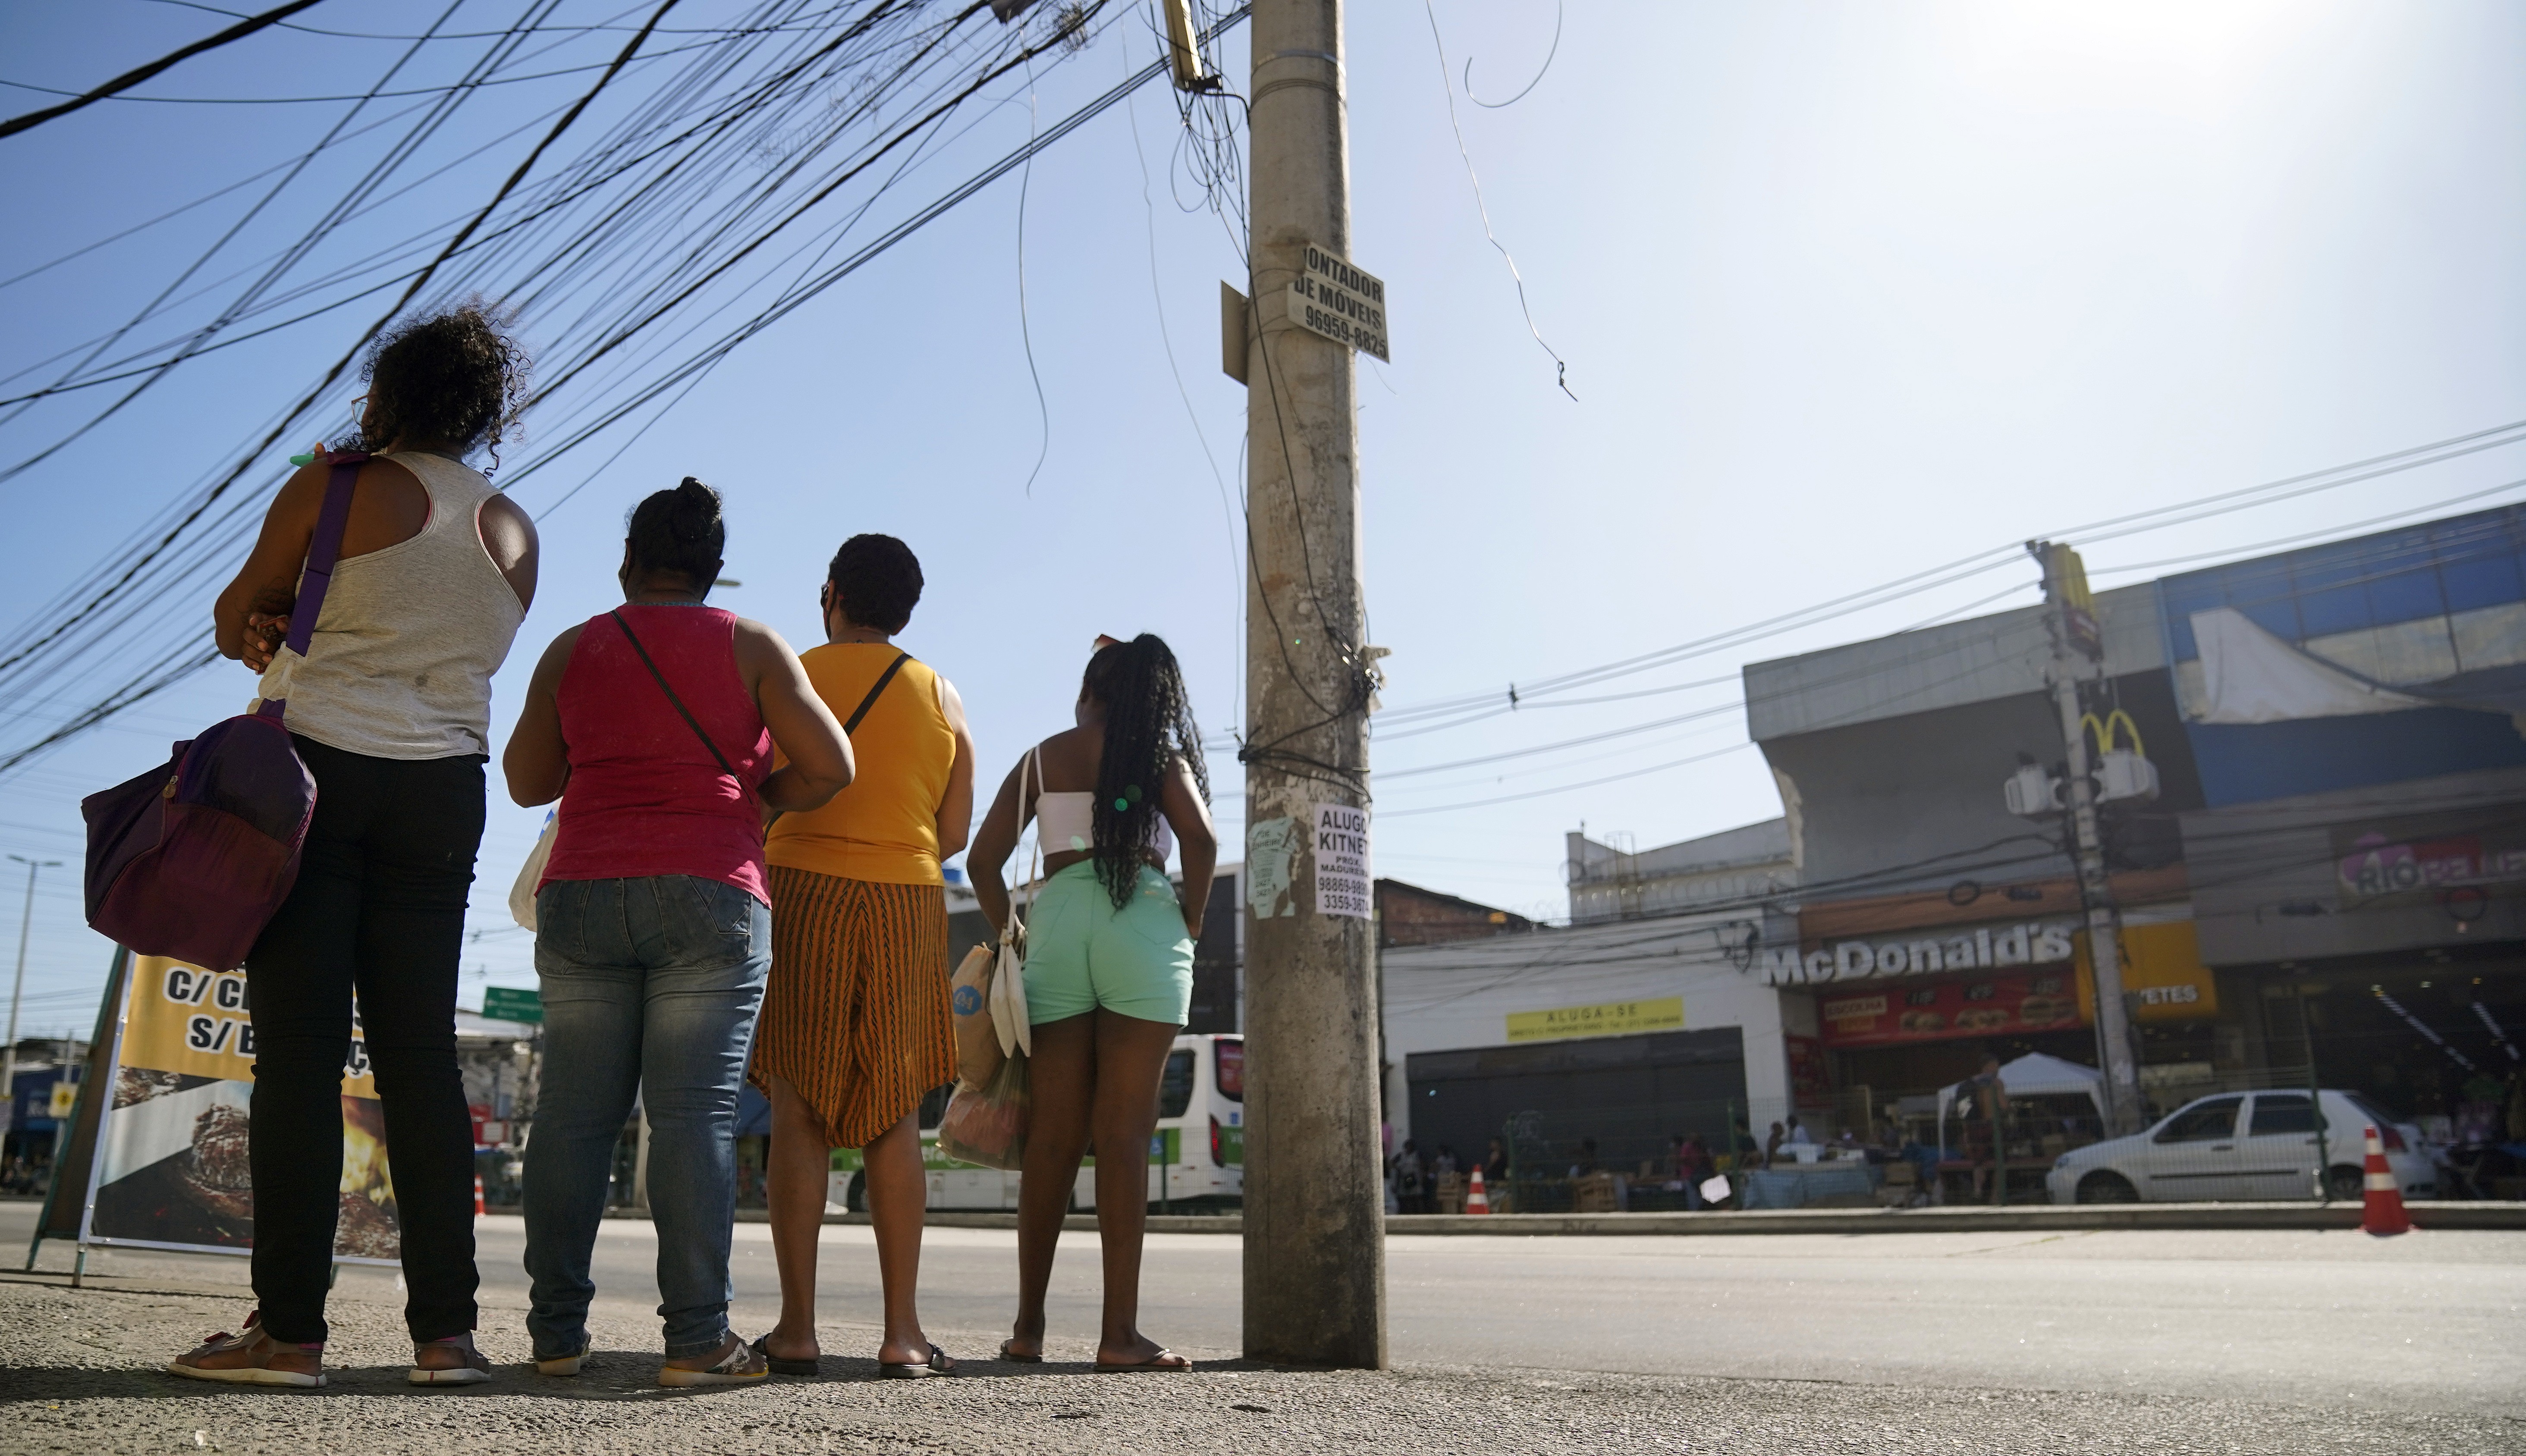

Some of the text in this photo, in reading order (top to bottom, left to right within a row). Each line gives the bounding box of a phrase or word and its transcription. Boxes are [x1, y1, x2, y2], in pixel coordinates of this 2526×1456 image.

[1294, 276, 1382, 331] DE MÓVEIS
[1303, 247, 1381, 304] ONTADOR
[1305, 304, 1387, 358] 96959-8825
[1760, 923, 2073, 986] McDonald's
